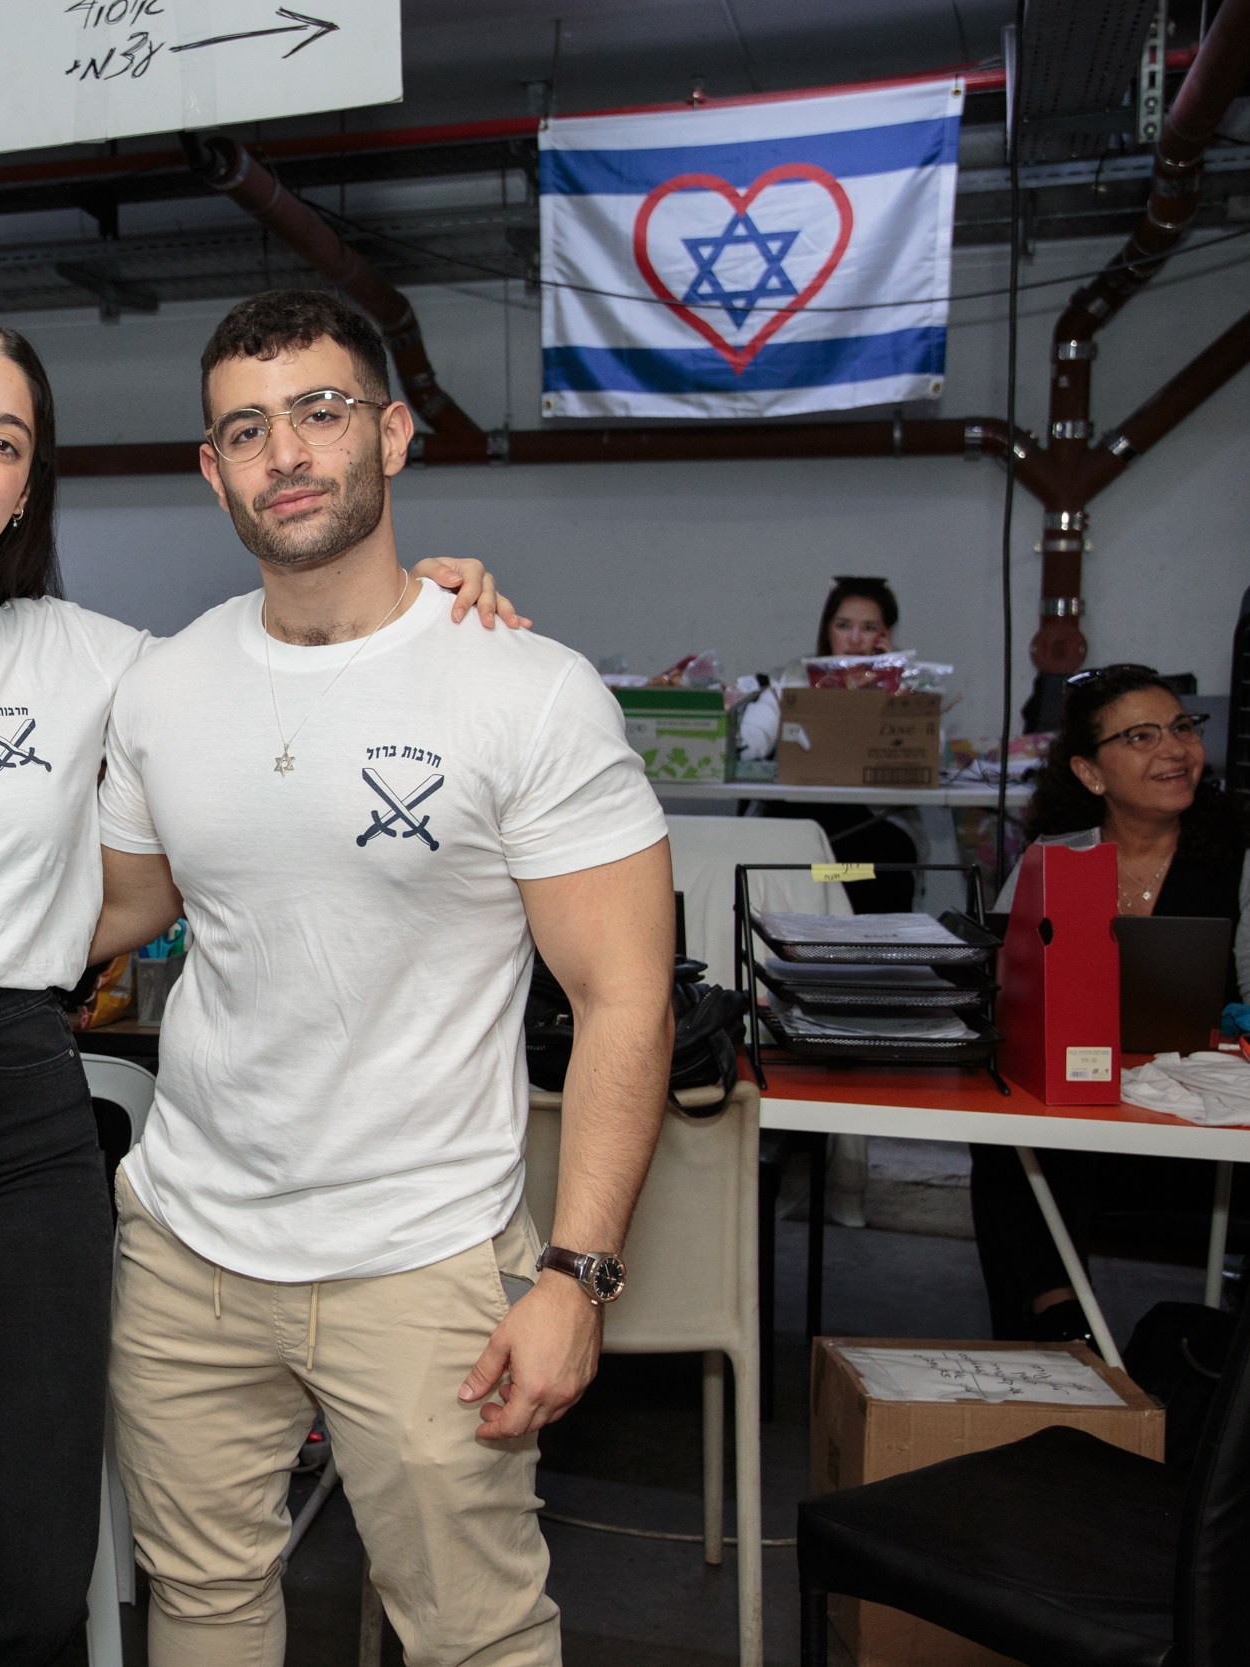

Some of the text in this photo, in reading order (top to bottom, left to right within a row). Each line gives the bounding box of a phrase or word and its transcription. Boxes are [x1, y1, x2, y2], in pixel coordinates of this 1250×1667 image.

[65, 31, 166, 81] עצמי
[366, 745, 442, 768] חרבות ברזל
